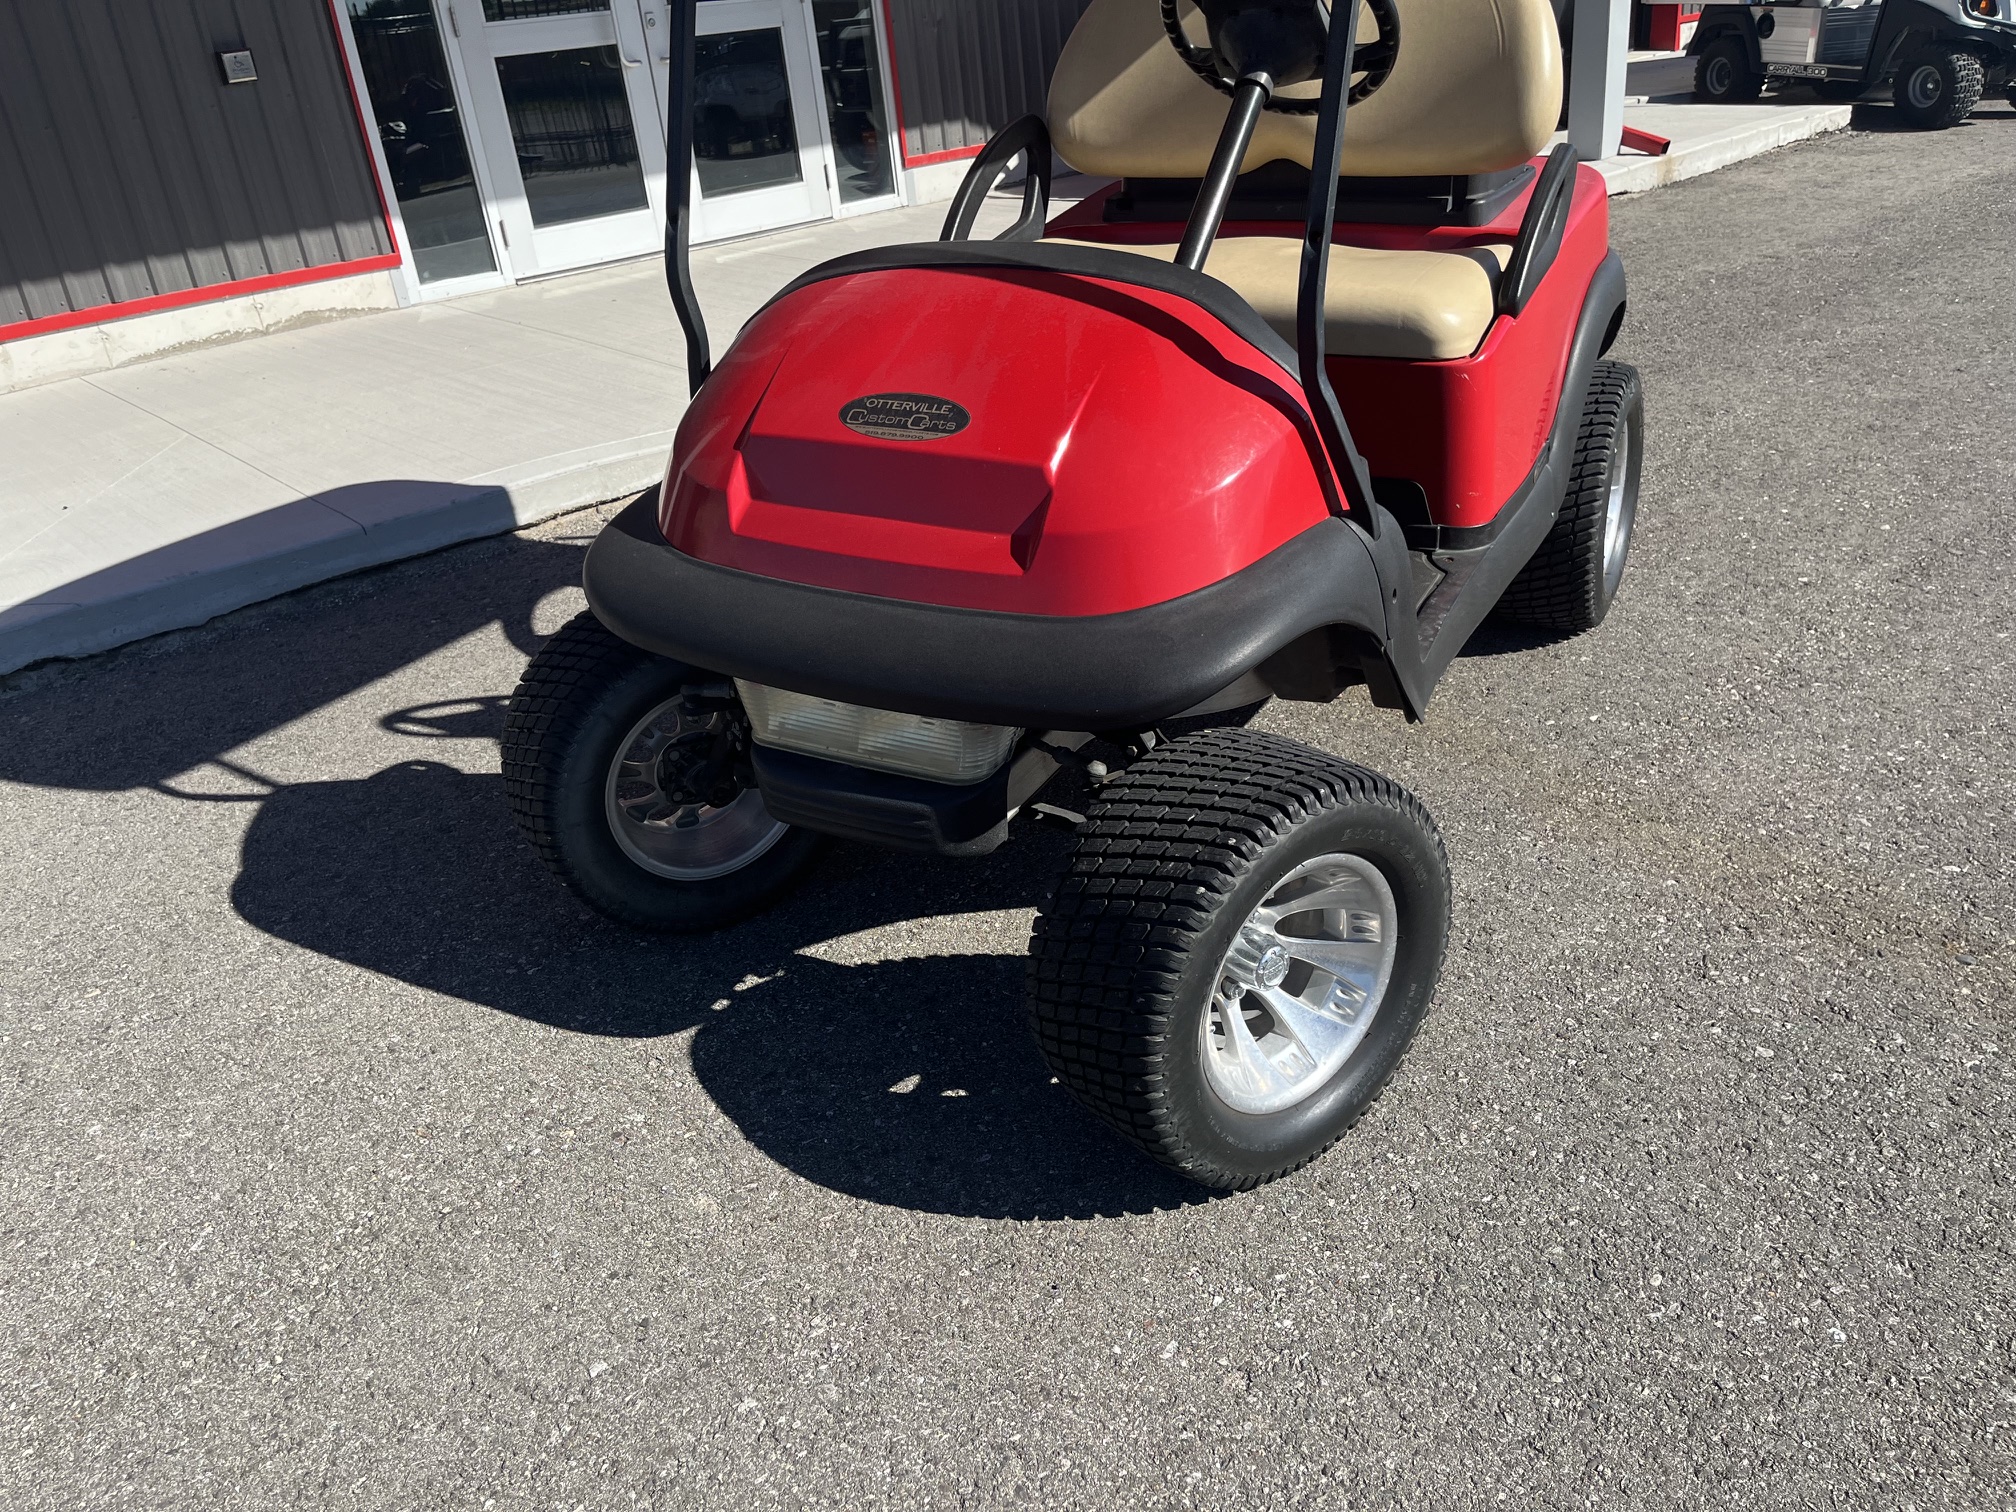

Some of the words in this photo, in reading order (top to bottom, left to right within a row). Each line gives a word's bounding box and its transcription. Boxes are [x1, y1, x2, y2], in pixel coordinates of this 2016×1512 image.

[1767, 64, 1806, 75] CARRYALL
[1807, 67, 1827, 77] 300
[866, 398, 952, 414] OTTERVILLE
